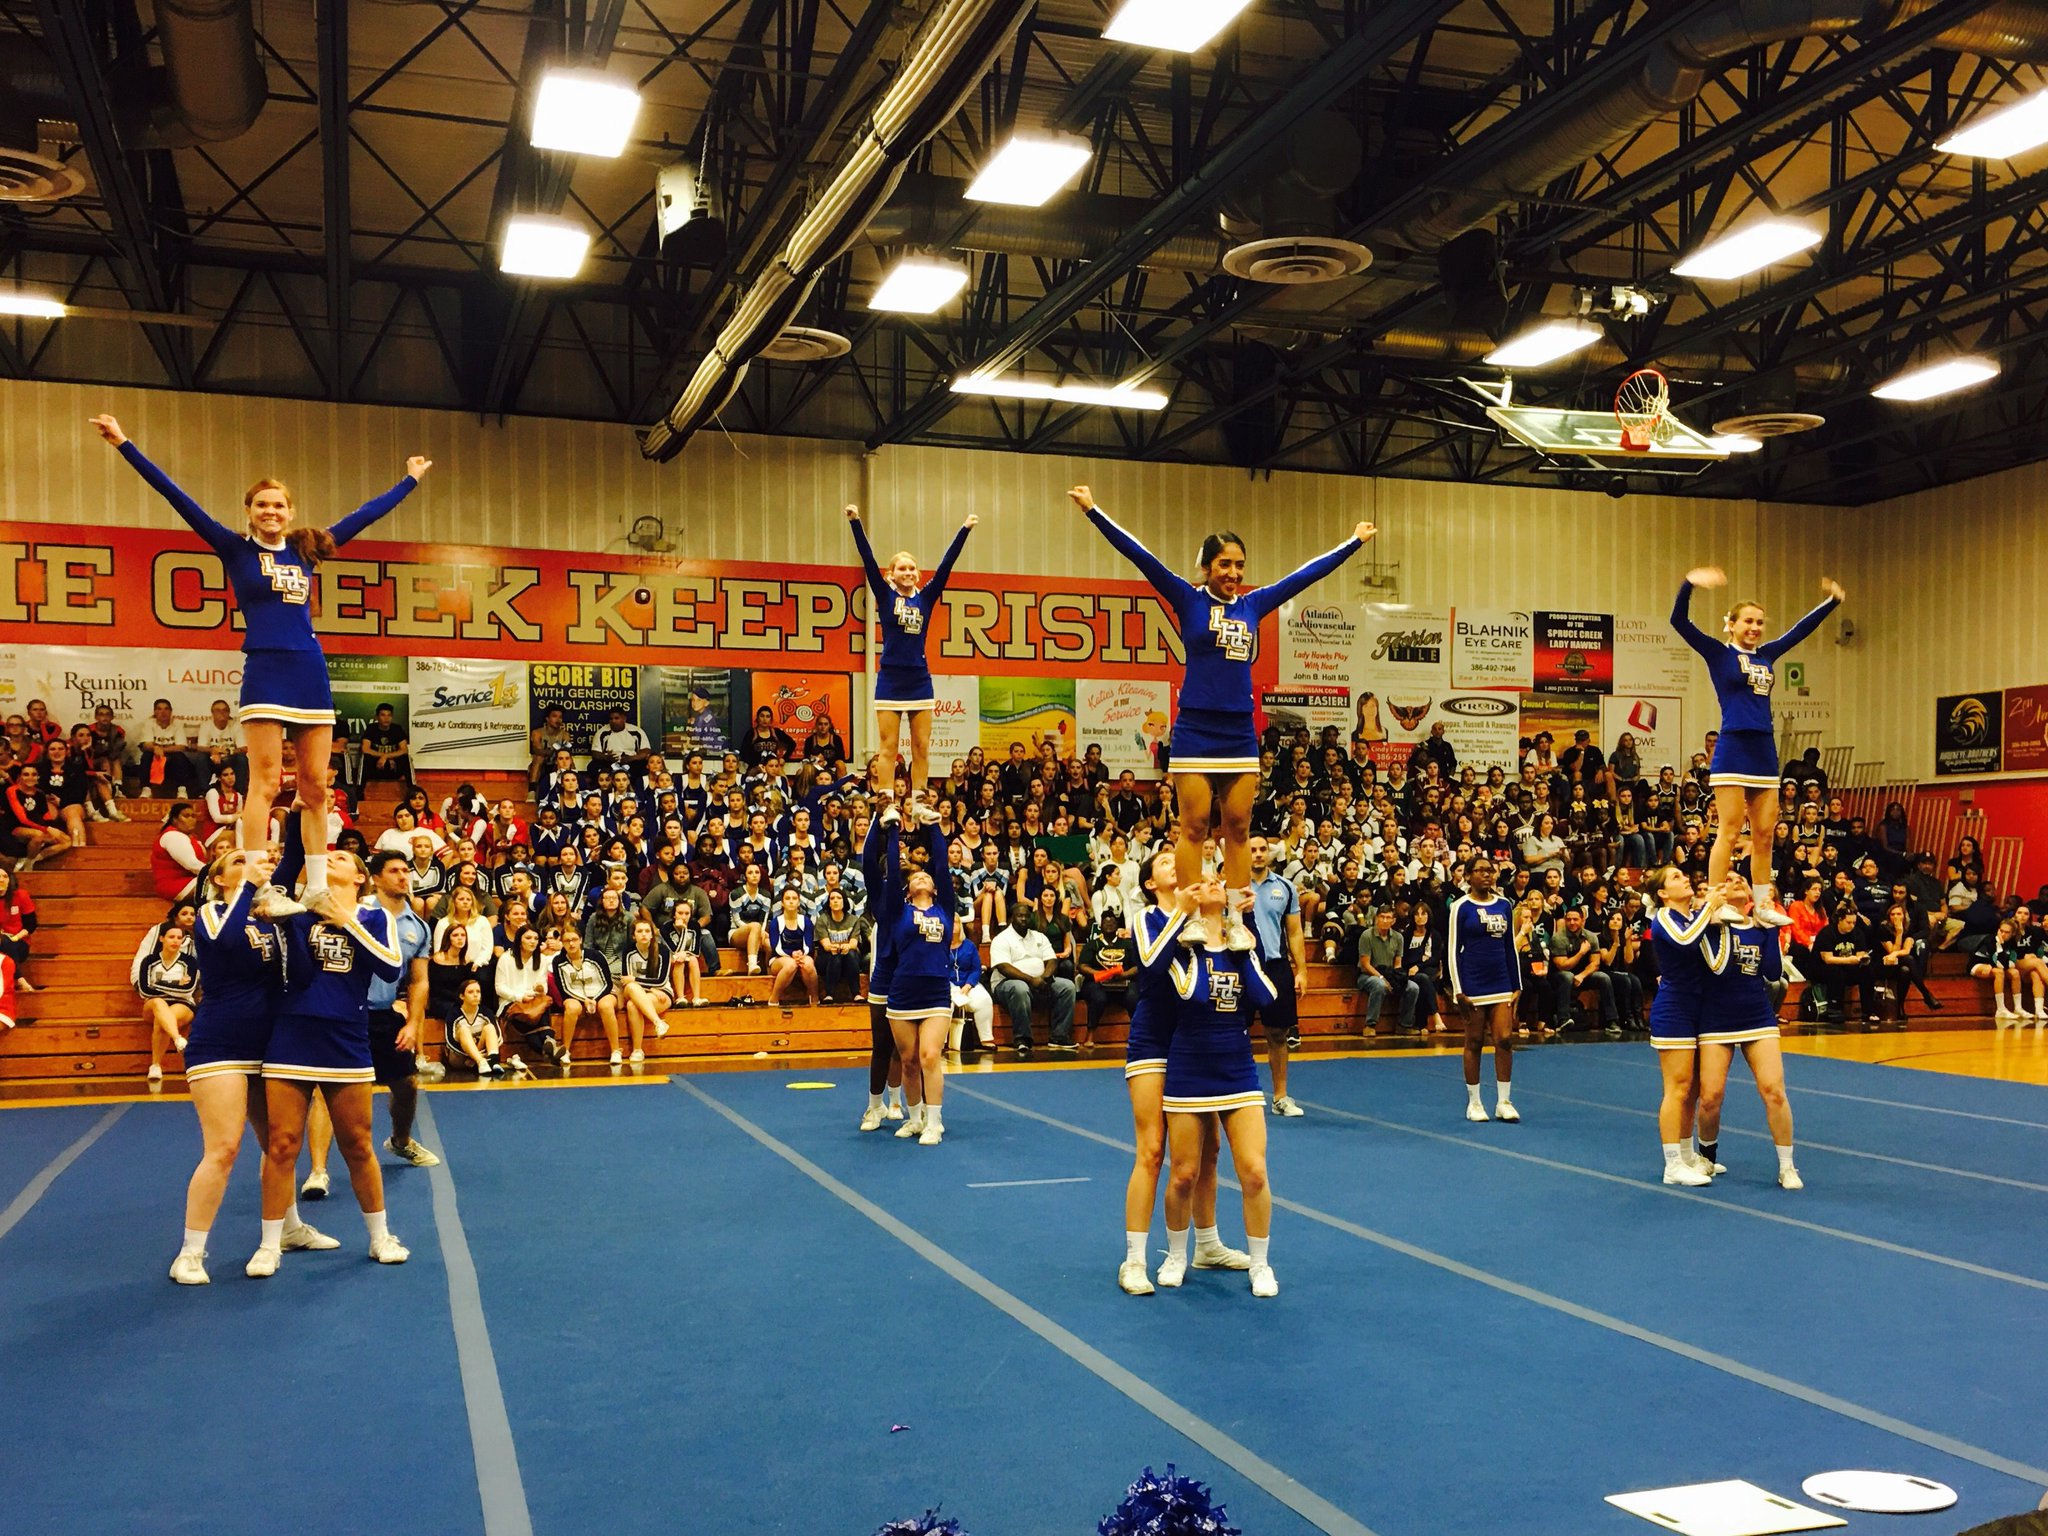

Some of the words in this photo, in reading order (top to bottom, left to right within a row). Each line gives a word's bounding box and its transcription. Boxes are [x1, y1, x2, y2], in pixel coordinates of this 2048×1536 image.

[259, 553, 310, 604] LHS
[152, 549, 543, 642] CEEK
[941, 588, 1258, 667] RISIN
[1305, 609, 1339, 619] Atlantic
[894, 597, 923, 634] LHS
[1568, 614, 1601, 622] SUPPORTERS
[1287, 619, 1356, 630] Cardiovascular
[1457, 622, 1529, 638] BLAHNIK
[1616, 620, 1646, 629] LLOYD
[1209, 606, 1252, 661] LHS
[1547, 629, 1577, 639] SPRUCE
[1580, 630, 1603, 639] CREEK
[1616, 634, 1667, 644] DENTISTRY
[1465, 638, 1487, 647] EYE
[1491, 639, 1522, 649] CARE
[1549, 640, 1569, 648] LADY
[1570, 641, 1601, 650] HAWKS!
[1294, 650, 1310, 660] Lady
[1311, 651, 1332, 661] Hawks
[1334, 652, 1348, 662] Play
[1392, 648, 1437, 661] TILE
[340, 661, 364, 669] CREEK
[1304, 661, 1319, 671] With
[1321, 662, 1338, 671] Heart
[533, 665, 593, 687] SCORE
[601, 667, 632, 688] BIG
[1738, 655, 1774, 696] LHS
[65, 672, 147, 692] Reunion
[433, 686, 493, 708] Service
[533, 688, 564, 697] WITH
[568, 689, 635, 699] GENEROUS
[81, 691, 132, 709] Bank
[1308, 695, 1347, 706] EASIER!
[412, 720, 435, 730] Heating,
[437, 721, 446, 729] Air
[448, 720, 482, 731] Conditioning
[490, 722, 525, 732] Refrigeration
[1634, 736, 1656, 746] OWE
[913, 911, 944, 943] LHS
[308, 923, 354, 973] LHS
[1205, 957, 1243, 1012] LHS
